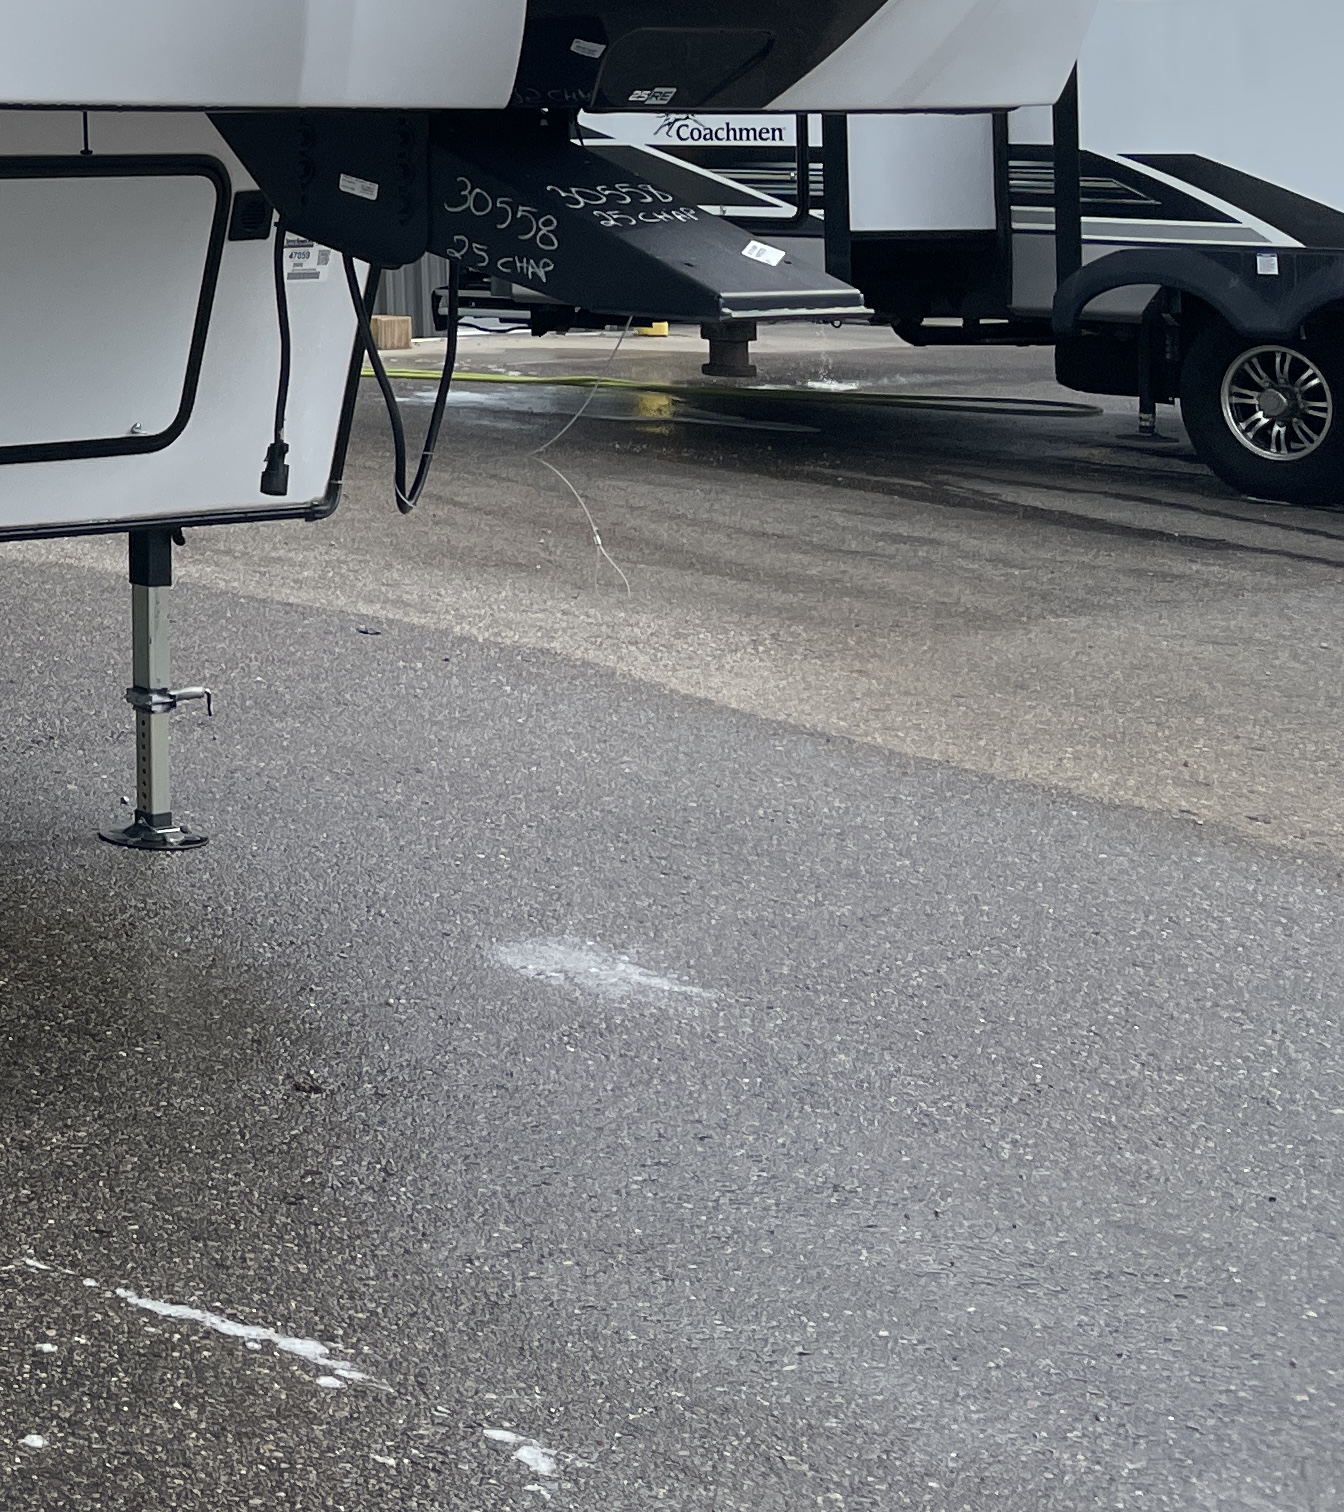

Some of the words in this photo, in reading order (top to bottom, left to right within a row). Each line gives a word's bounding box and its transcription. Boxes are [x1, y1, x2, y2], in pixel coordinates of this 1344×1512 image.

[675, 122, 784, 142] Coachmen
[546, 183, 673, 209] 30558
[443, 176, 559, 251] 30558
[592, 210, 637, 227] 25
[638, 206, 699, 223] CHAP
[446, 235, 490, 267] 25
[497, 255, 555, 283] CHAP
